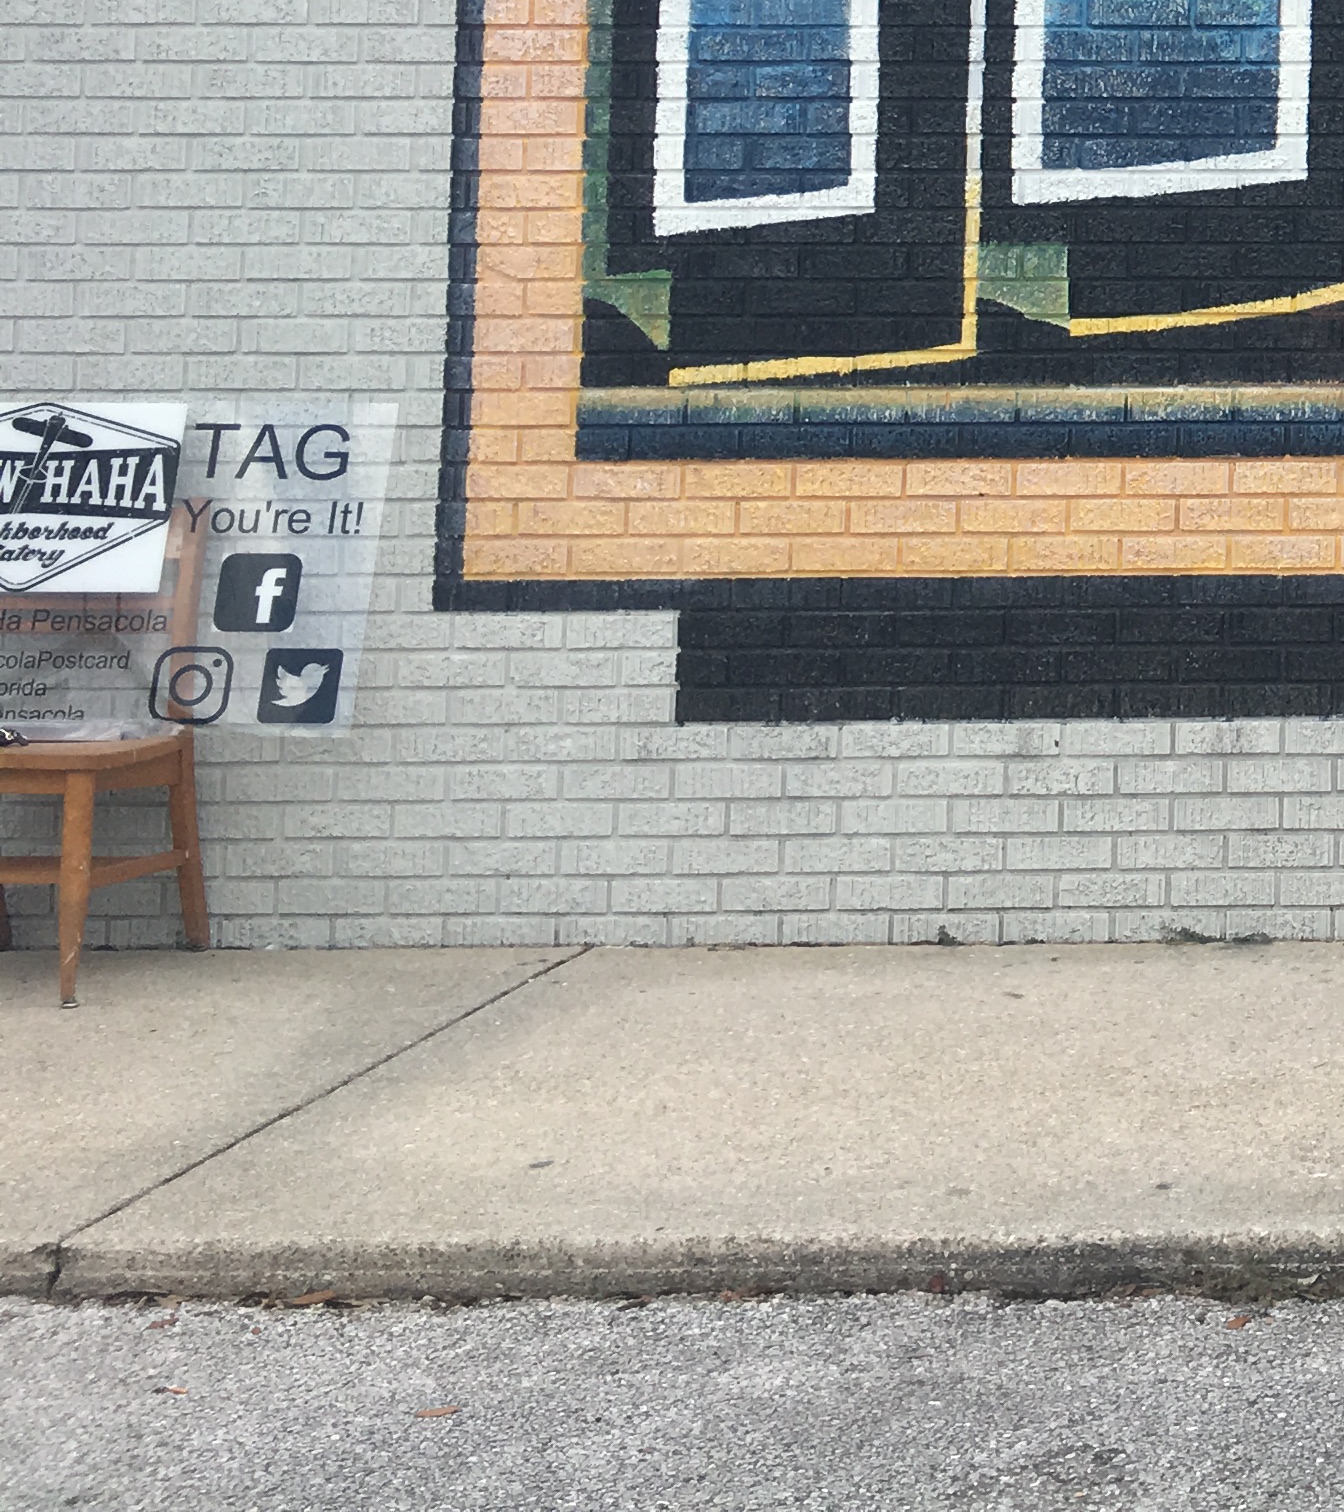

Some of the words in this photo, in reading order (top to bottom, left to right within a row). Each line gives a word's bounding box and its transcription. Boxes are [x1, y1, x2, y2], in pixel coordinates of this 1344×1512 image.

[195, 423, 351, 481] TAG
[183, 499, 312, 536] You're
[328, 501, 364, 535] It!
[31, 609, 168, 633] Pensacola
